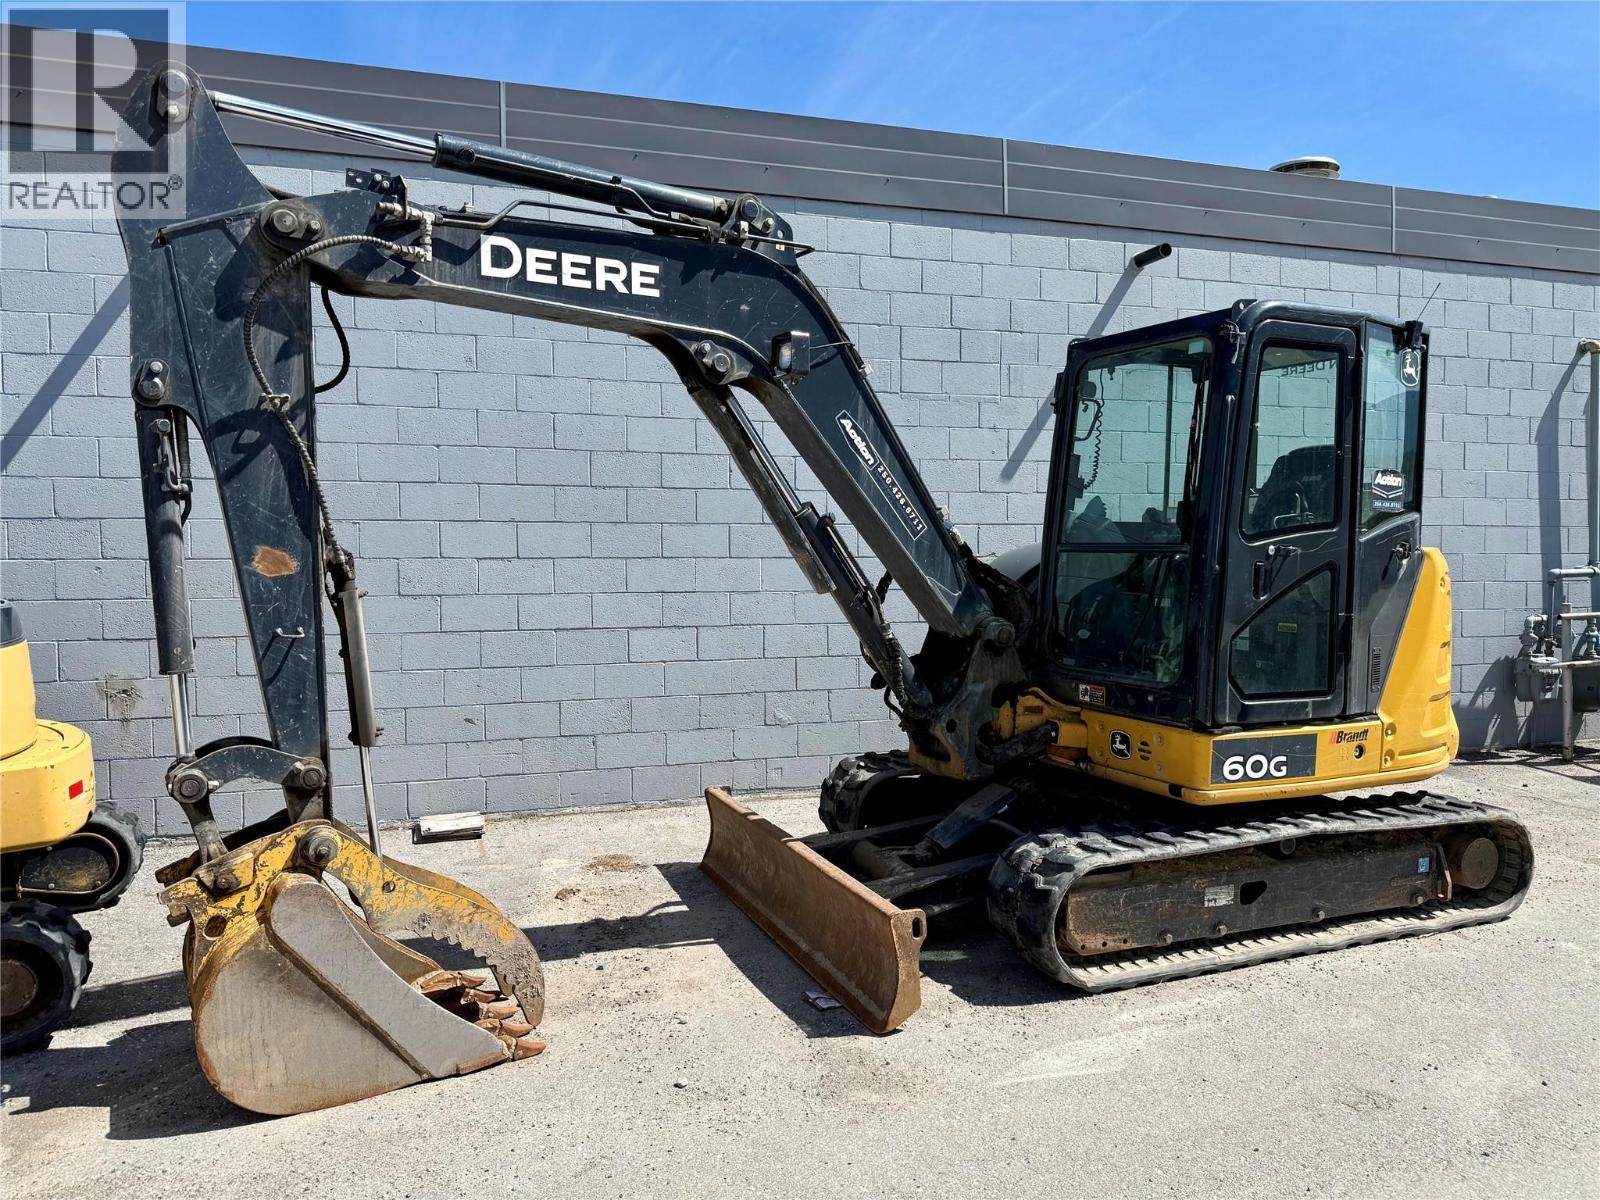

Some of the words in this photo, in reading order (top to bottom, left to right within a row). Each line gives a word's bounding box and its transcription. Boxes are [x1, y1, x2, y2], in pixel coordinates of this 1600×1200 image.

[480, 233, 661, 298] DEERE
[1335, 728, 1369, 744] Brandt
[1222, 753, 1288, 781] 60G
